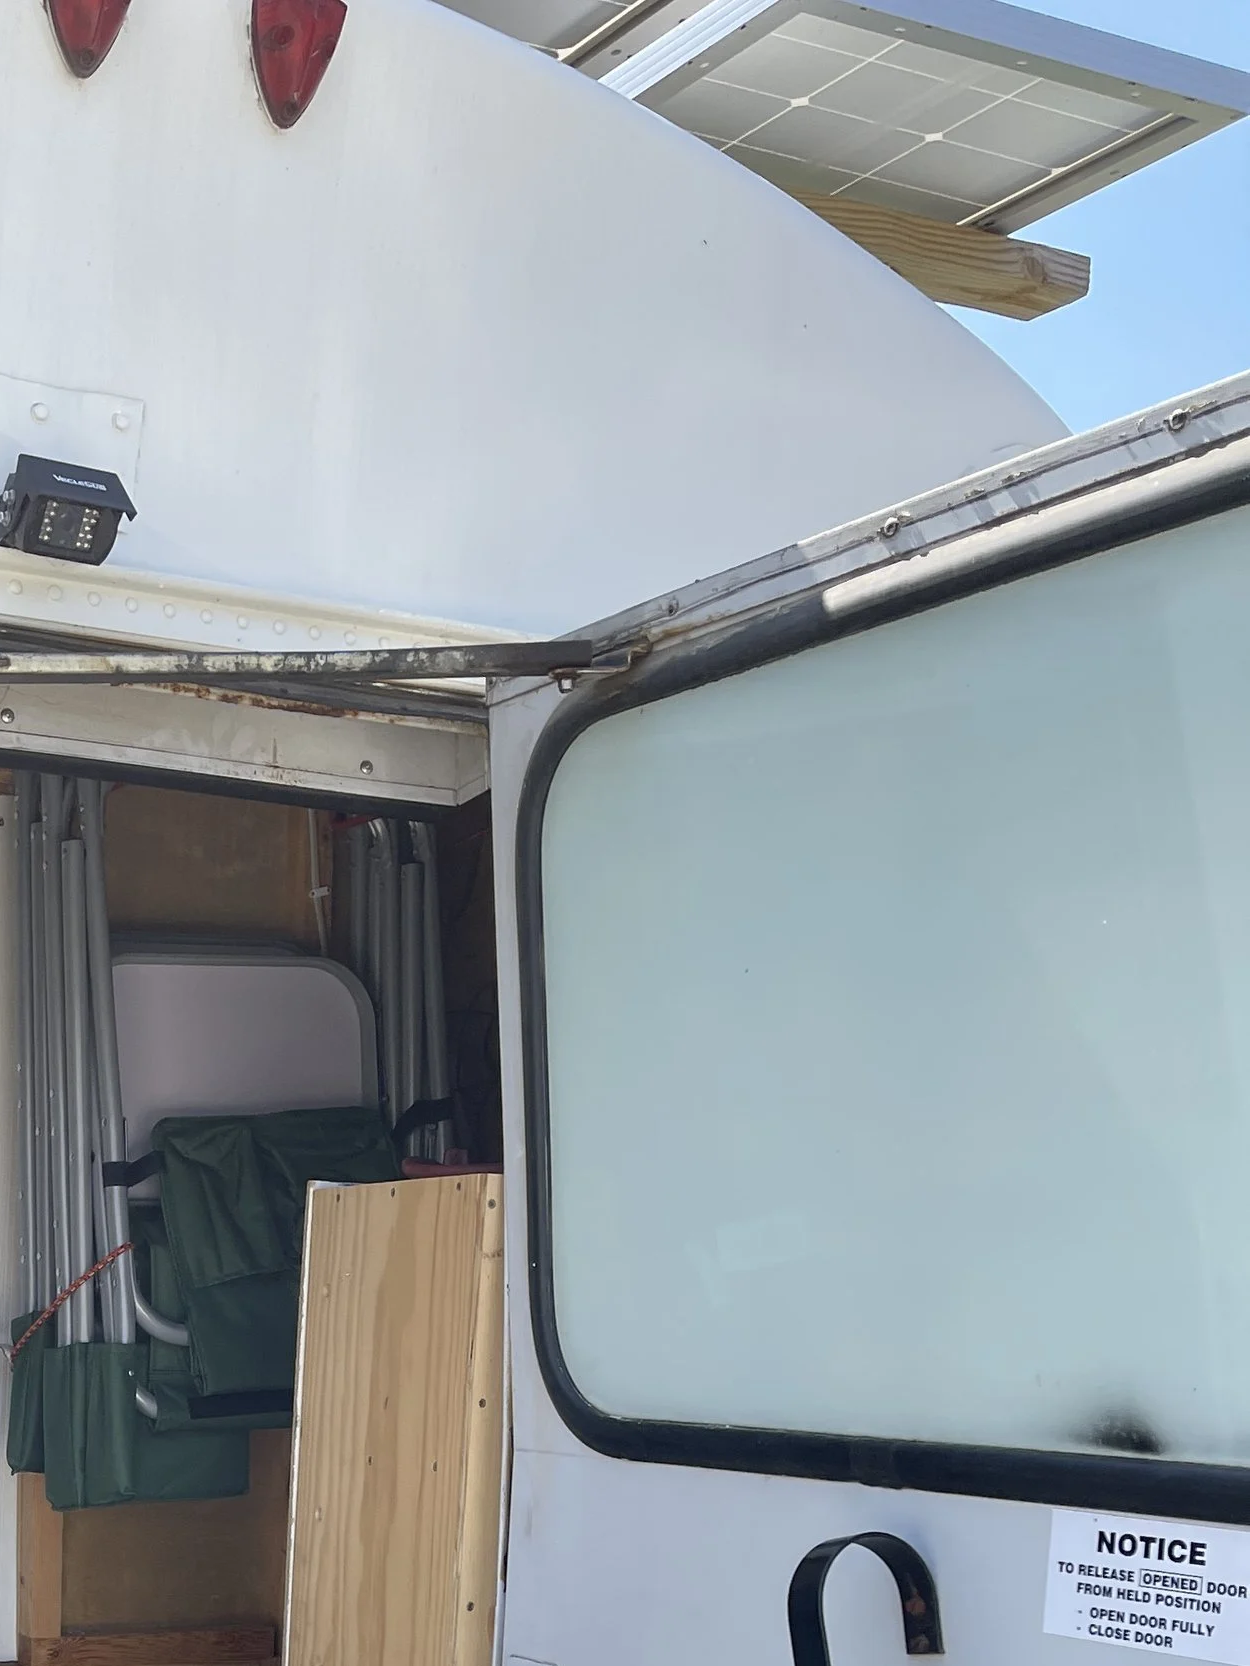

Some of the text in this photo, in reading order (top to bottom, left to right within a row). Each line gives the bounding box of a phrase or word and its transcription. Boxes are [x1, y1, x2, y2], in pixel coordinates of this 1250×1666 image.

[1096, 1530, 1208, 1567] NOTICE
[1057, 1560, 1248, 1599] TO RELEASE OPENED DOOR
[1076, 1581, 1222, 1615] FROM HELD POSITION
[1088, 1623, 1174, 1649] CLOSE DOOR
[1089, 1606, 1216, 1638] OPEN DOOR FULLY
